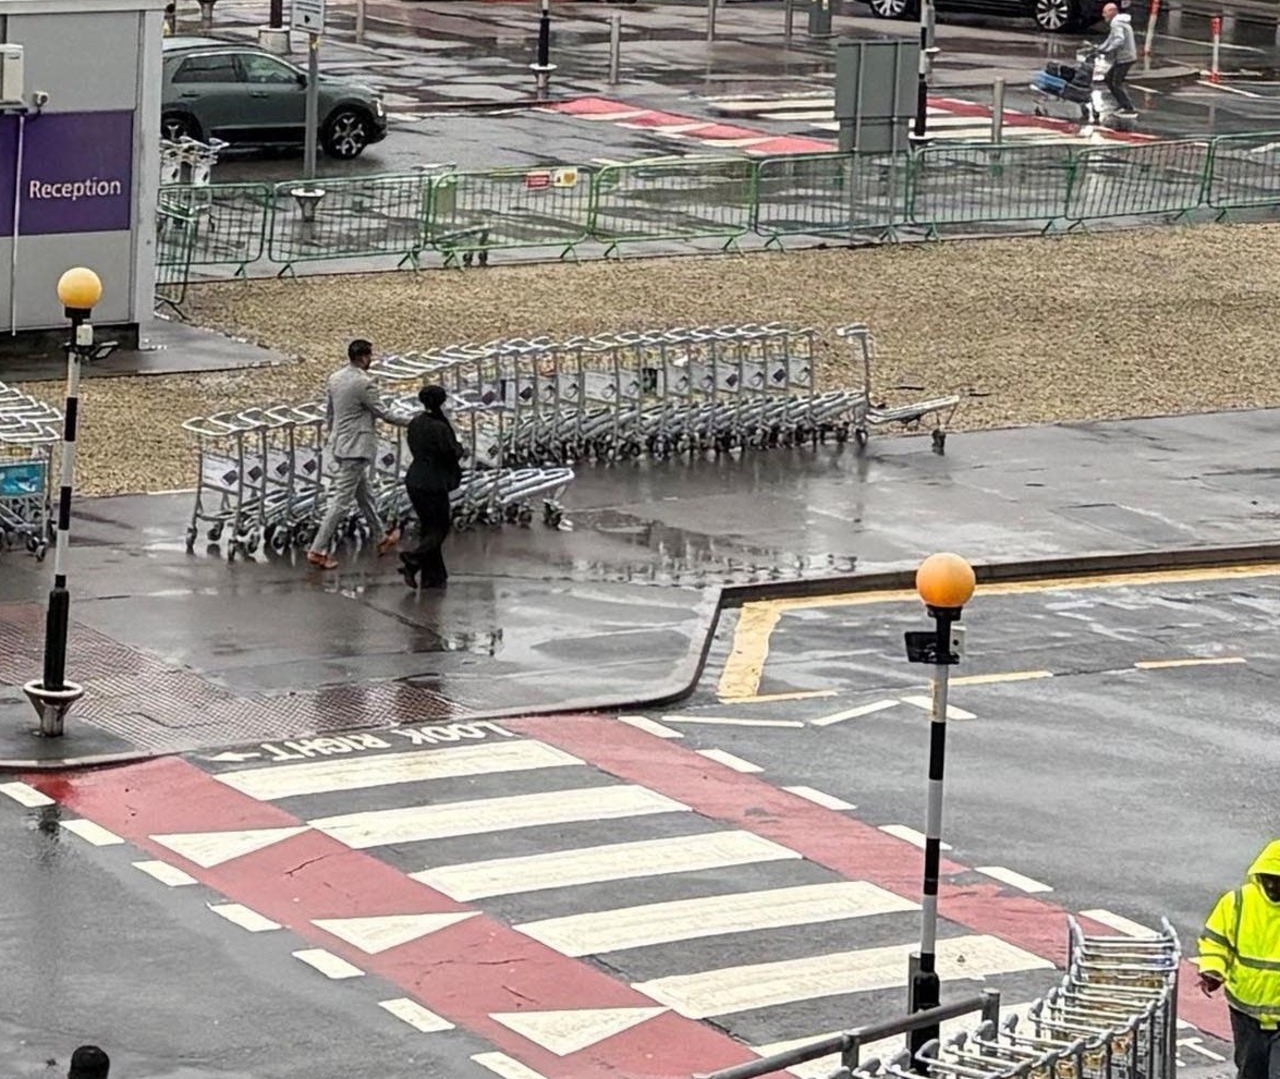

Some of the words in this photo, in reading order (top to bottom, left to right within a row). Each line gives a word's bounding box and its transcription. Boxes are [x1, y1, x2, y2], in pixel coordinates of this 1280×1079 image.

[29, 177, 122, 201] Reception
[393, 720, 514, 745] LOOK
[261, 734, 391, 761] RIGHT
